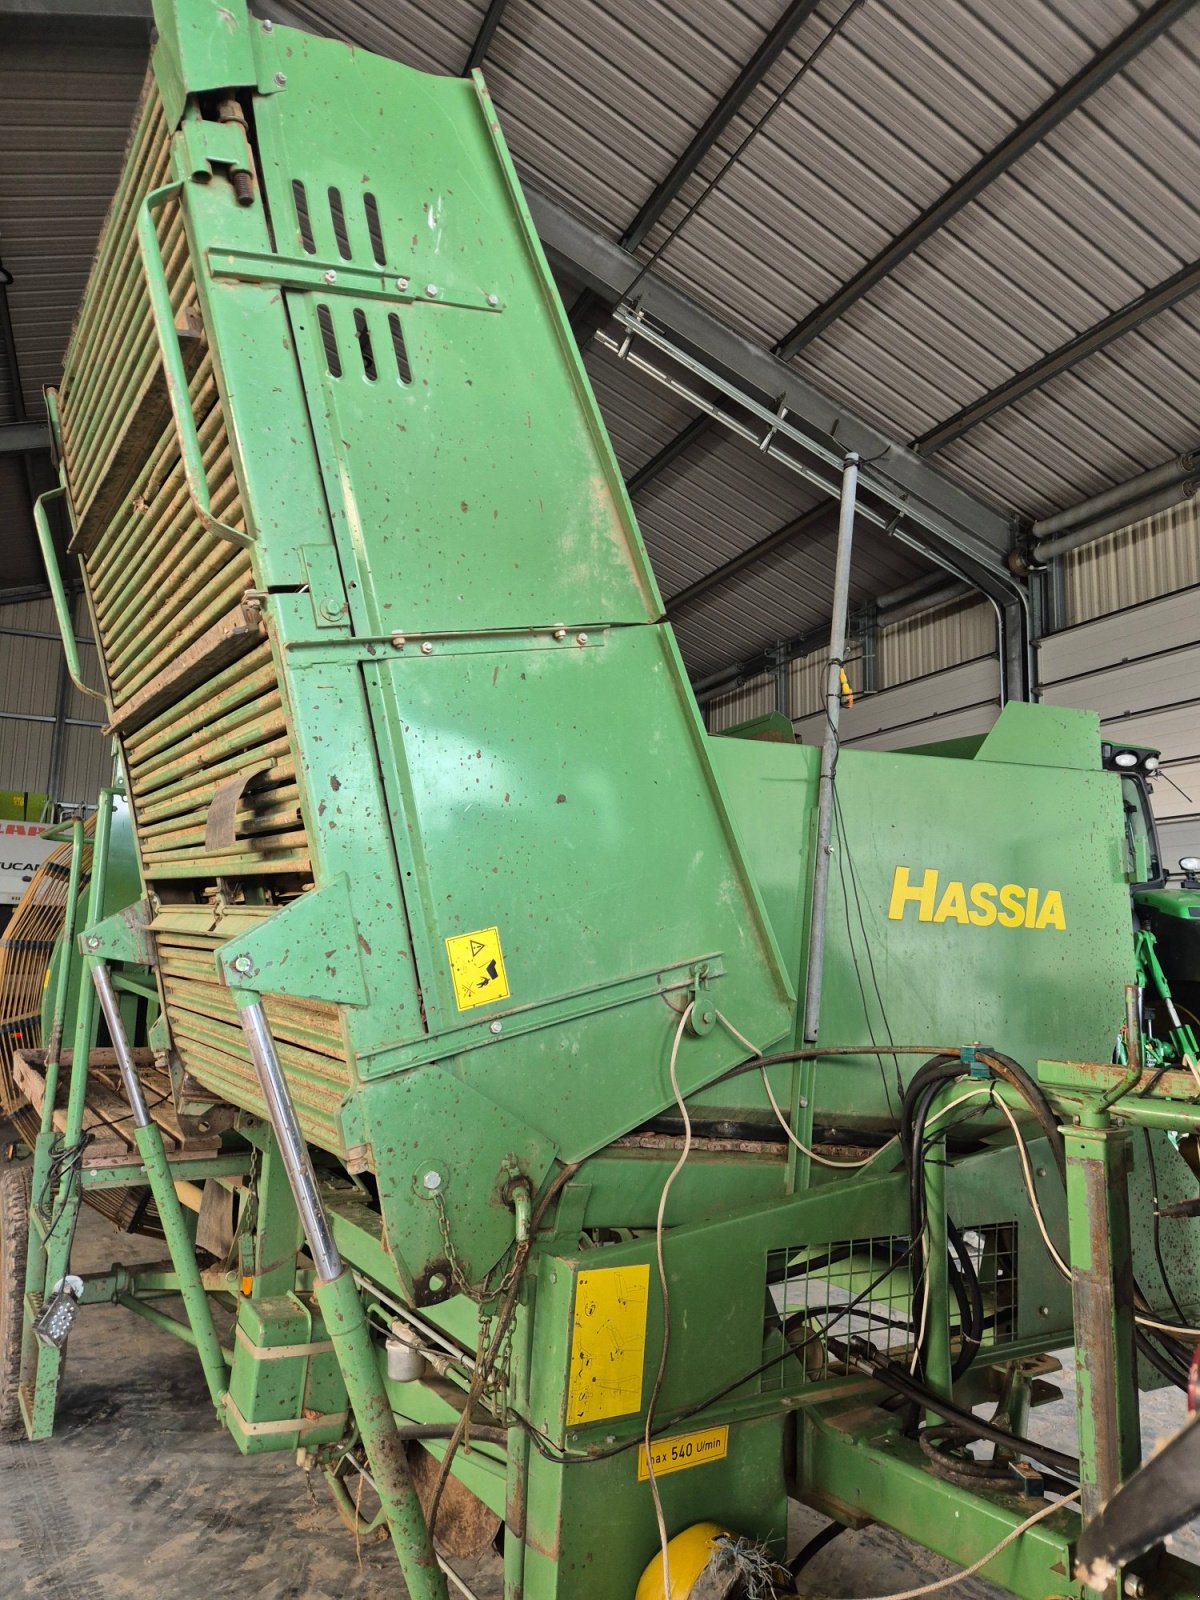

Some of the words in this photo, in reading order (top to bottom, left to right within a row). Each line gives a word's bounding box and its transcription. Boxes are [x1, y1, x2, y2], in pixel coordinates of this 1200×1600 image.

[888, 865, 1067, 931] HASSIA
[672, 1443, 692, 1460] 540
[696, 1438, 721, 1453] U/min
